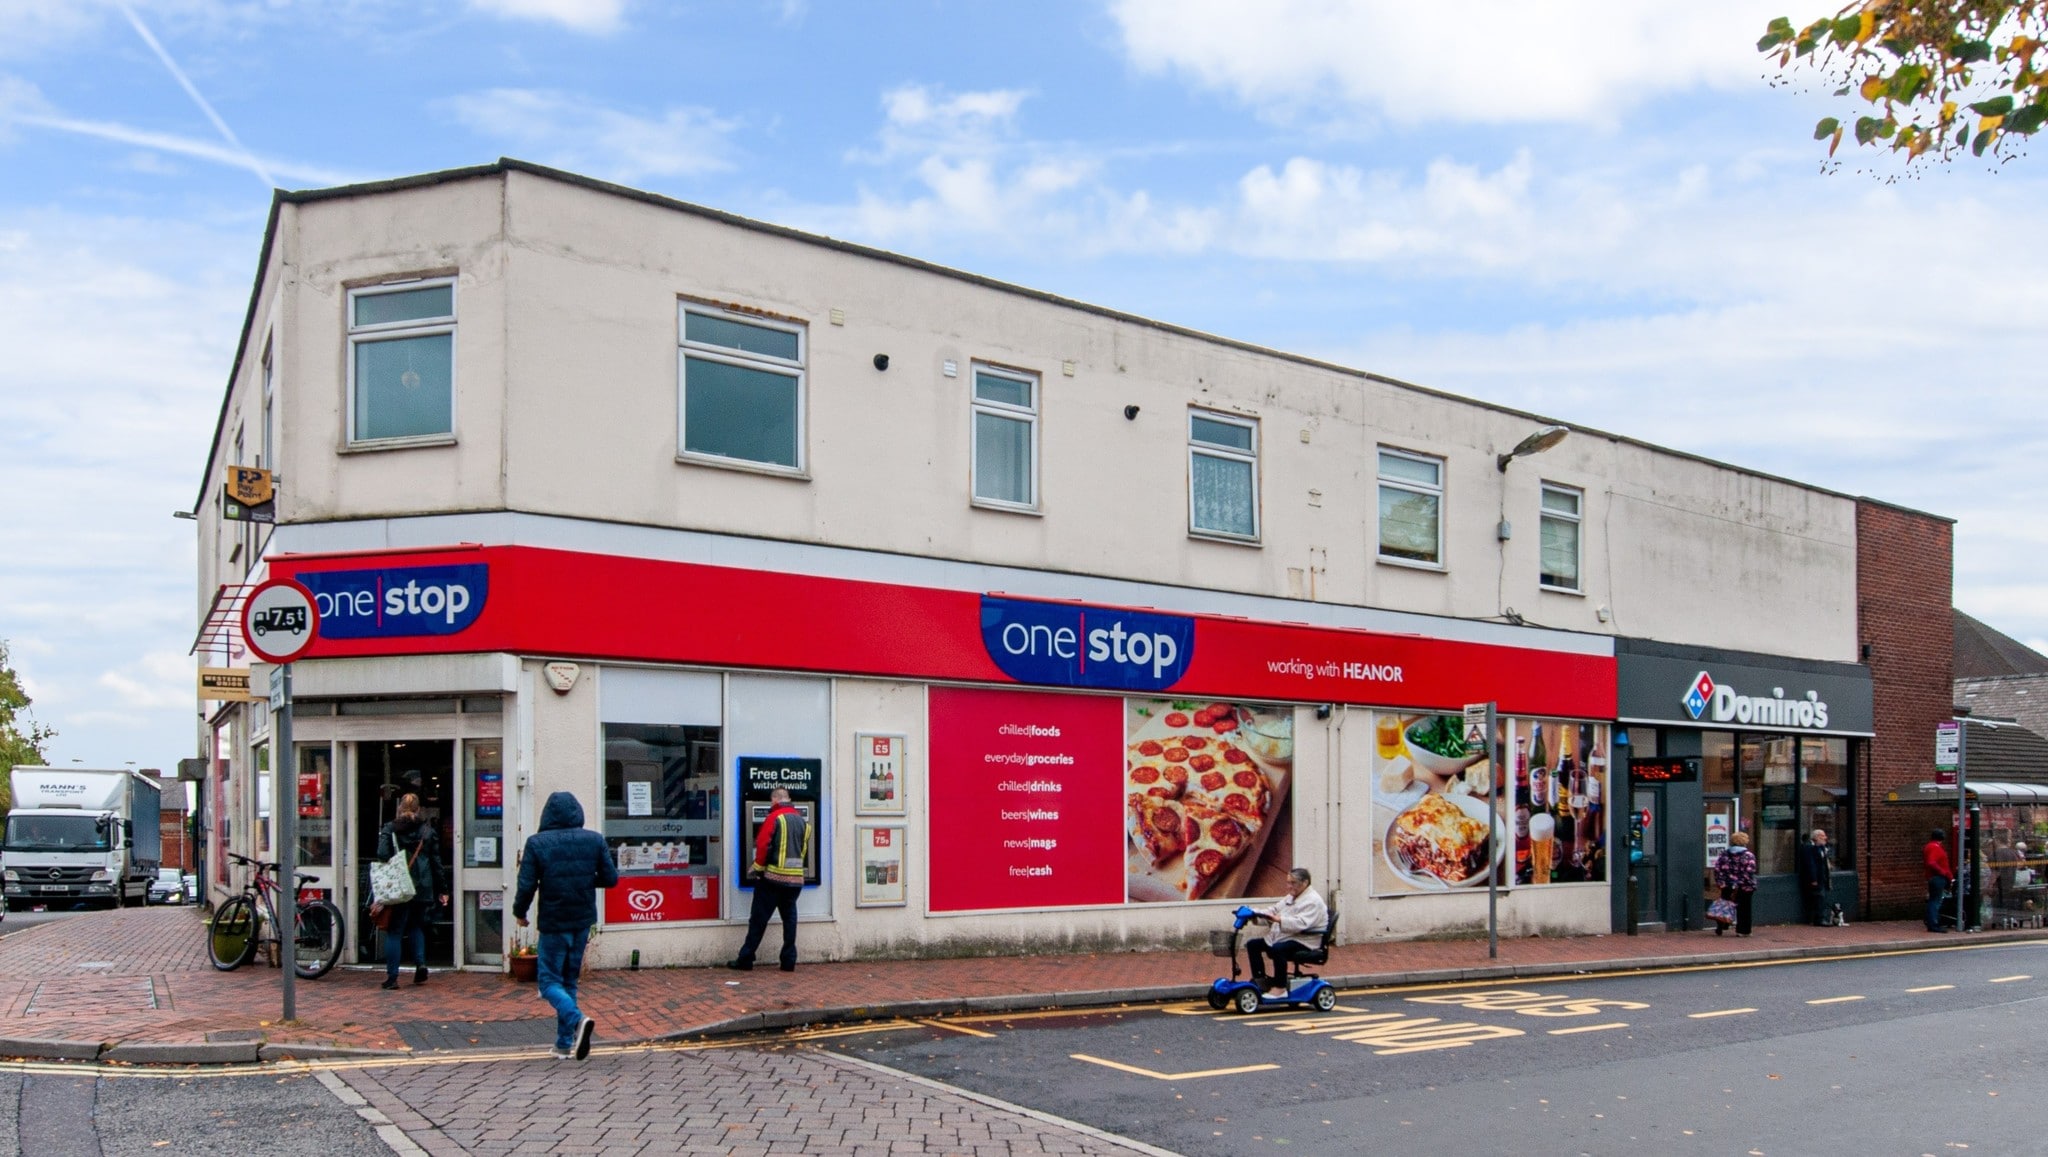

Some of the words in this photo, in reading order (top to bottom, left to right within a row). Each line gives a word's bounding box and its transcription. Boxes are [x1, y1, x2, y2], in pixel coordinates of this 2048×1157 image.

[314, 590, 374, 617] one
[384, 579, 470, 624] stop
[1002, 622, 1076, 659] one
[1088, 620, 1177, 679] stop
[1266, 657, 1314, 680] working
[1315, 659, 1341, 678] with
[1342, 661, 1404, 683] HEANOR
[1712, 684, 1829, 729] Domino's
[874, 744, 889, 754] £5
[749, 767, 778, 780] Free
[780, 767, 812, 780] Cash
[662, 823, 682, 833] stop
[630, 912, 662, 921] WALL'S
